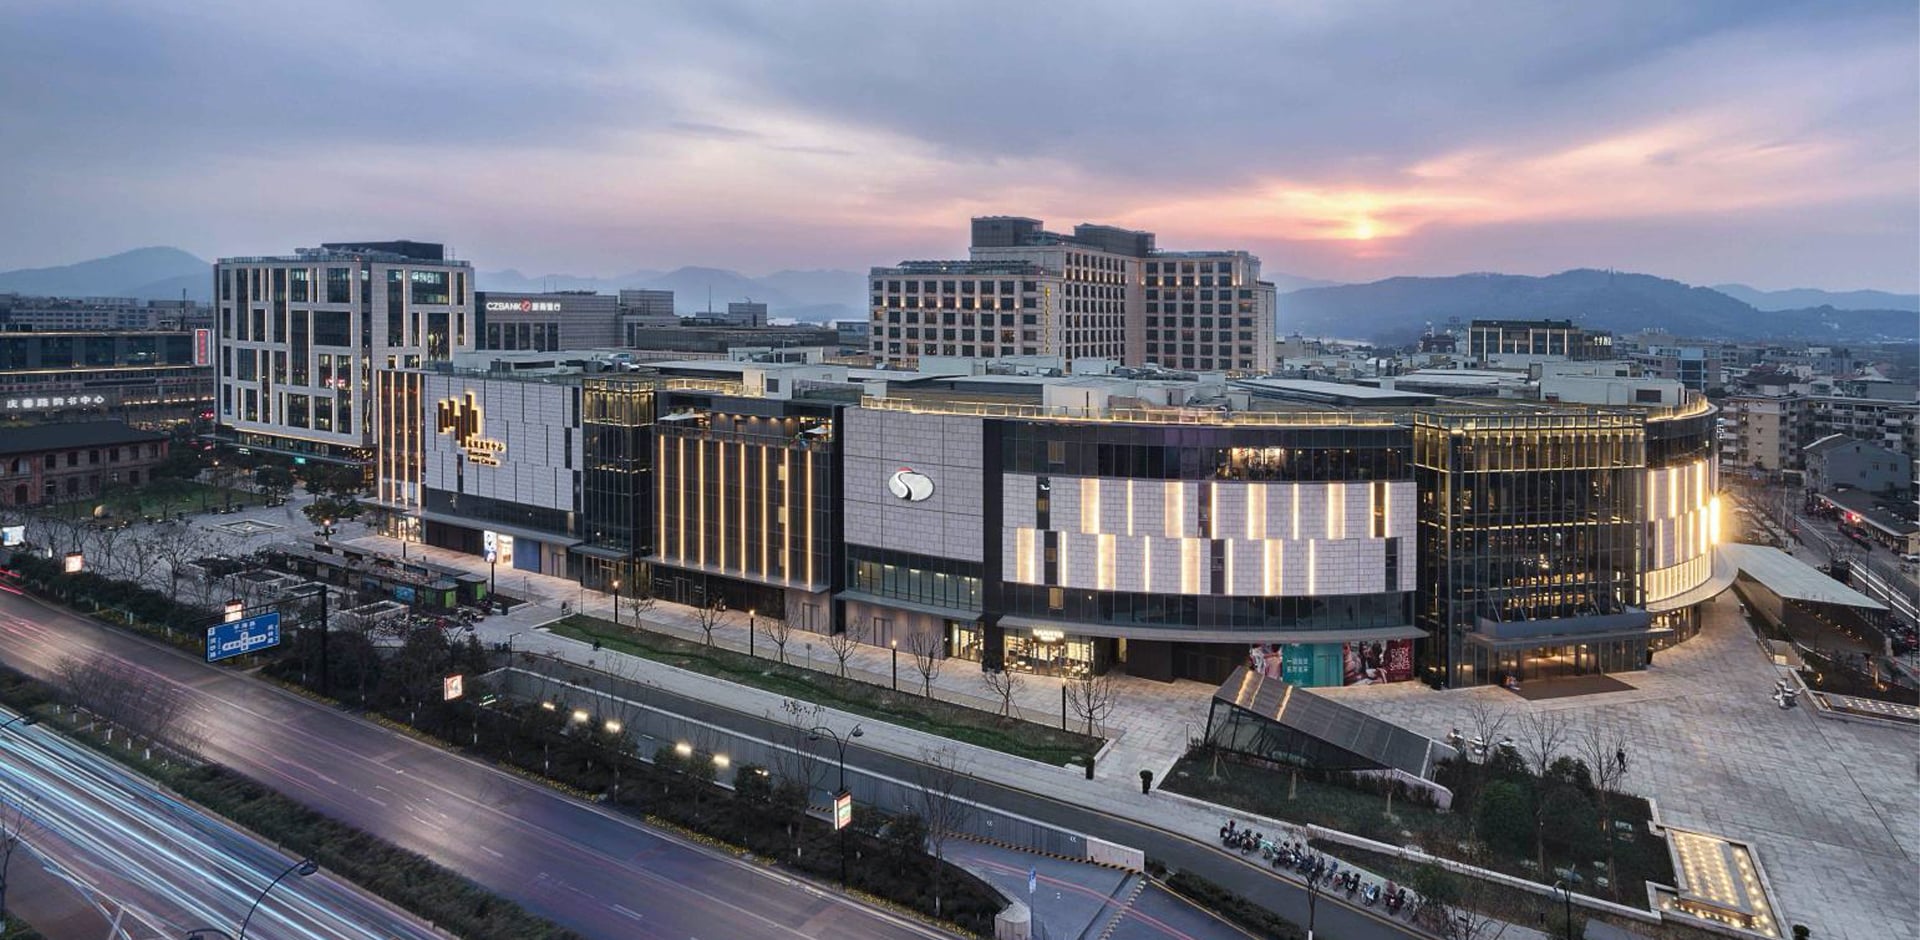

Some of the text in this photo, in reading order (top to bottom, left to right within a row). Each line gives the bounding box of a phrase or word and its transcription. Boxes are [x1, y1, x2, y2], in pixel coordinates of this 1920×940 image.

[486, 301, 522, 312] CZBANK
[6, 395, 105, 409] 庆春路购书中心
